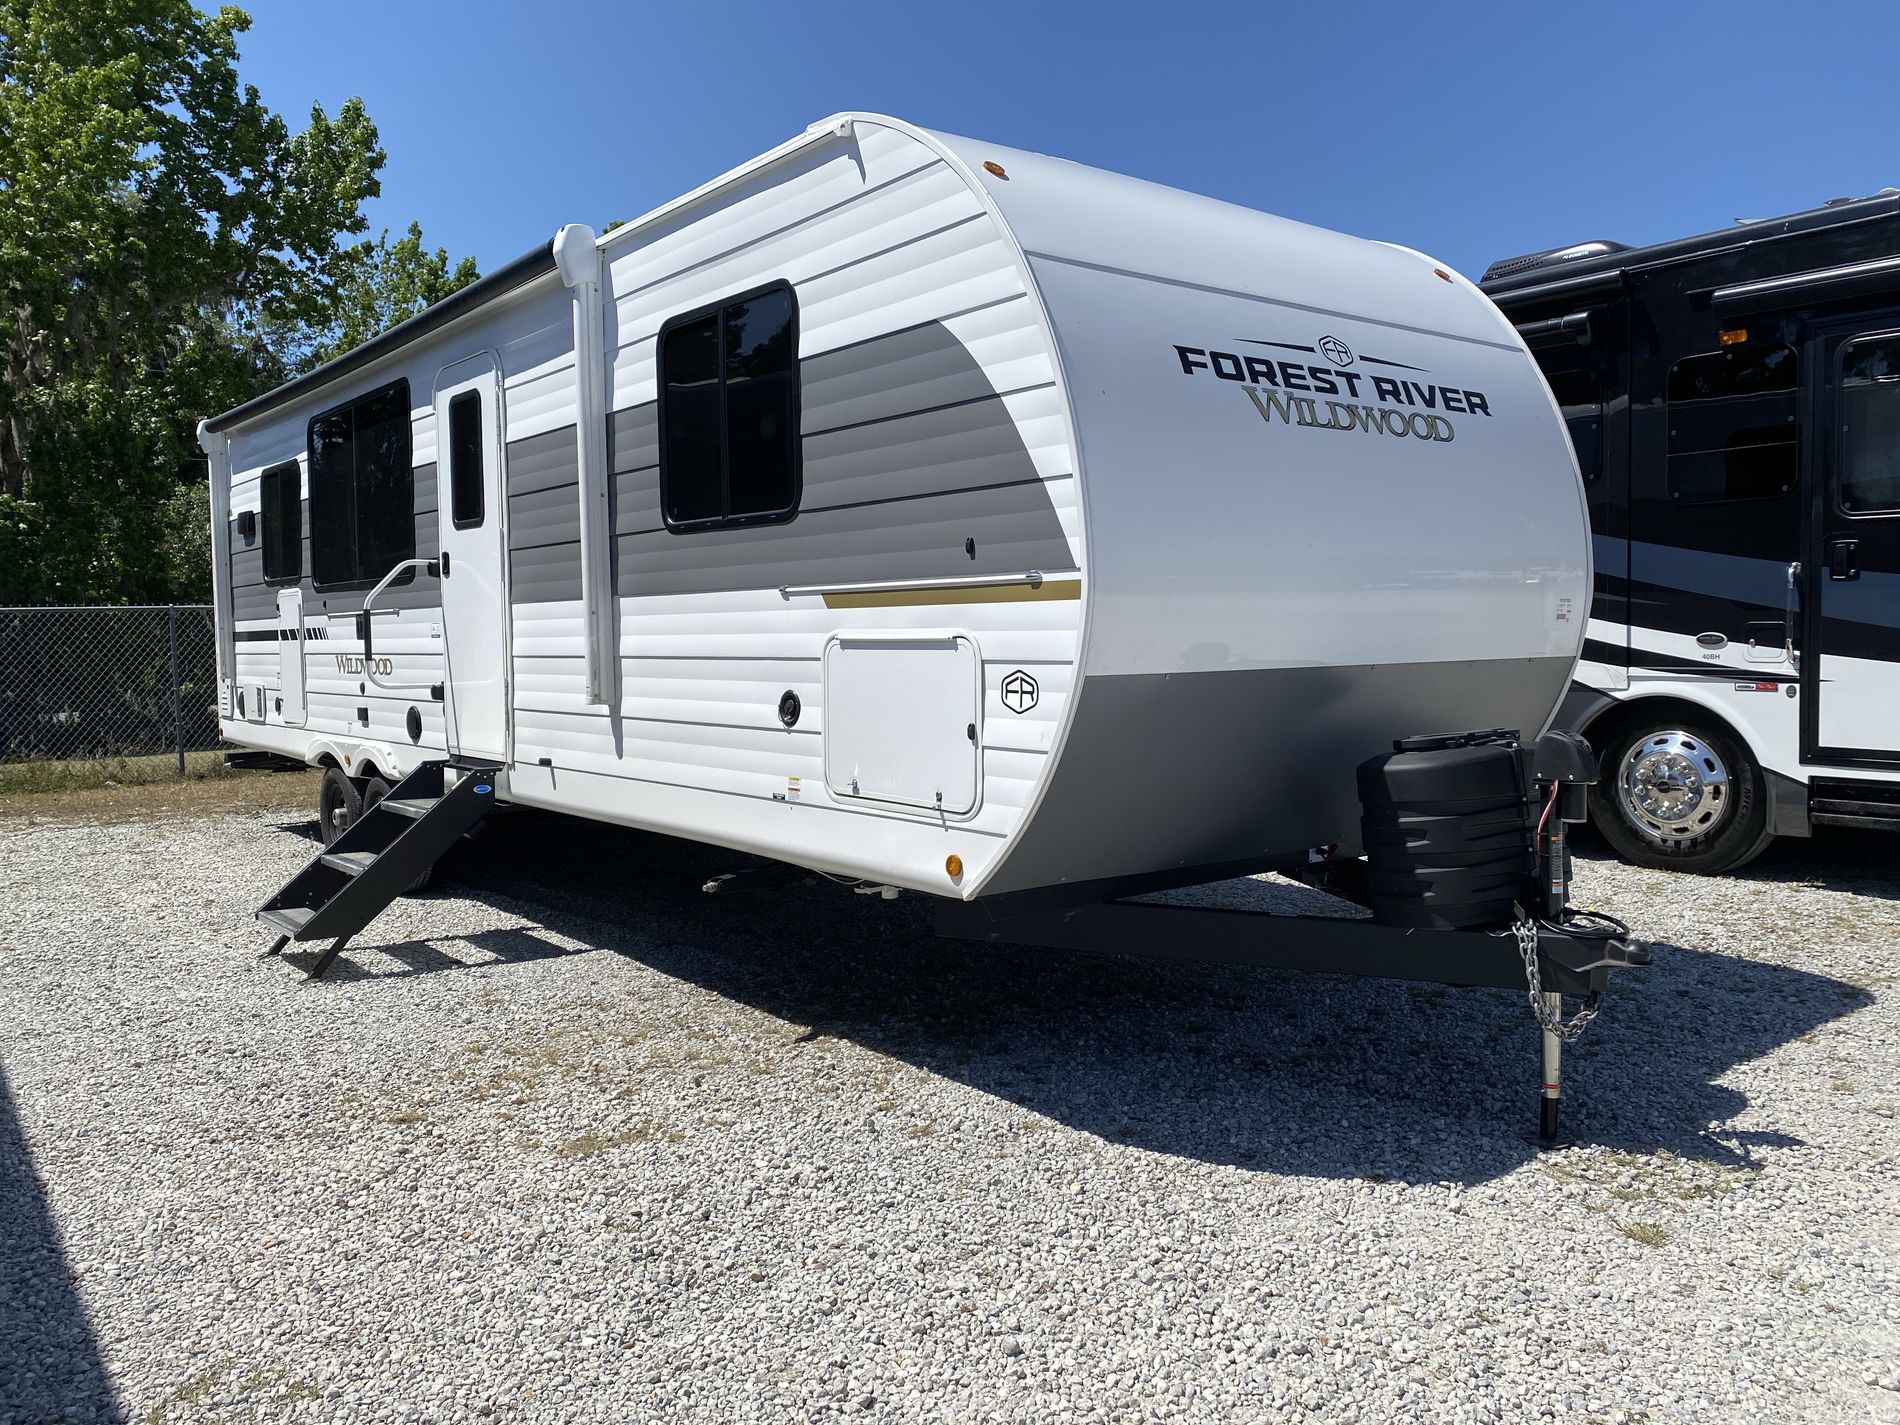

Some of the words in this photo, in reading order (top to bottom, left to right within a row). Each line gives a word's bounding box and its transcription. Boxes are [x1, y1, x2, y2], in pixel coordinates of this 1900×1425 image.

[1172, 344, 1361, 398] FOREST
[1370, 375, 1493, 417] RIVER
[1241, 384, 1455, 443] WILDWOOD
